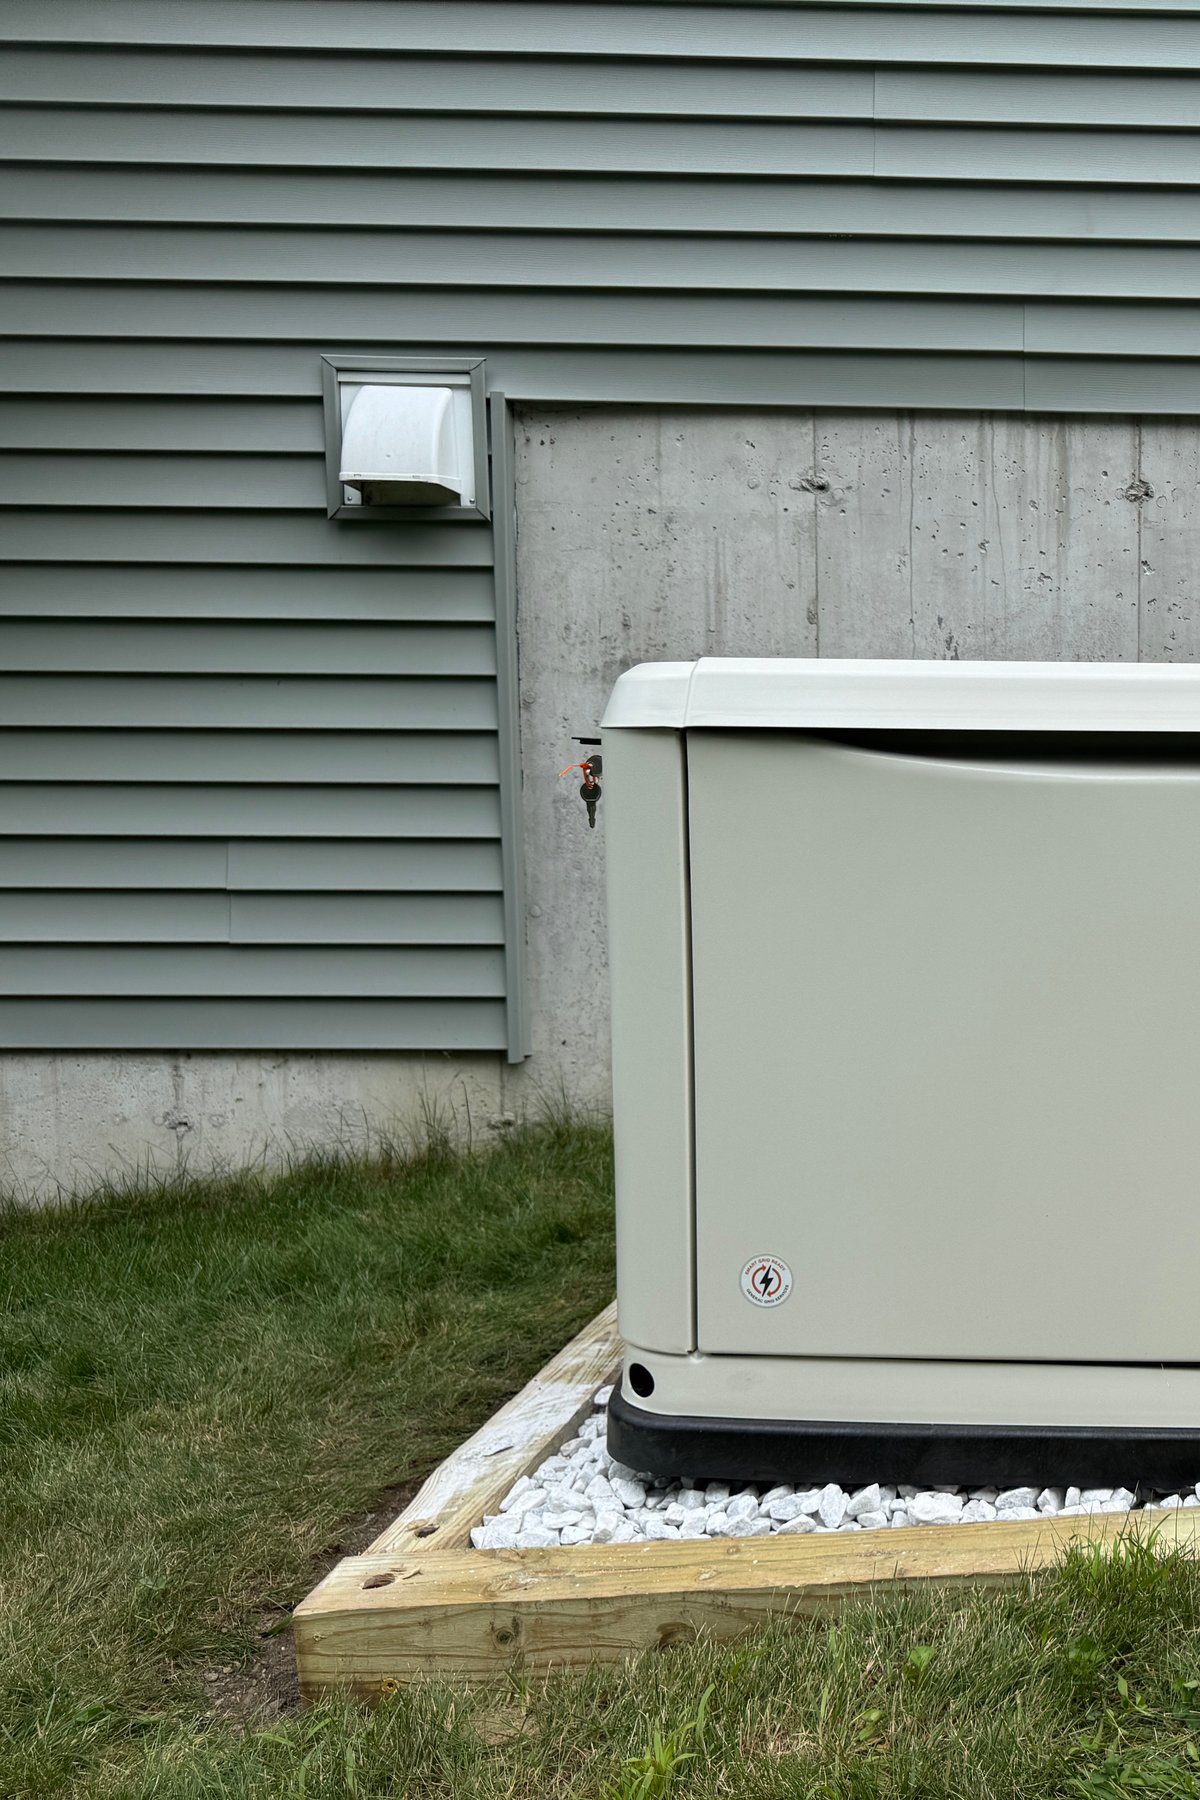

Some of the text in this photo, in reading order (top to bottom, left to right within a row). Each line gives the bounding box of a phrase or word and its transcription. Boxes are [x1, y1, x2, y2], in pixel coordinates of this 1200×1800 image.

[745, 1260, 758, 1275] SMART
[771, 1259, 786, 1271] READY
[746, 1288, 763, 1303] GENERAC
